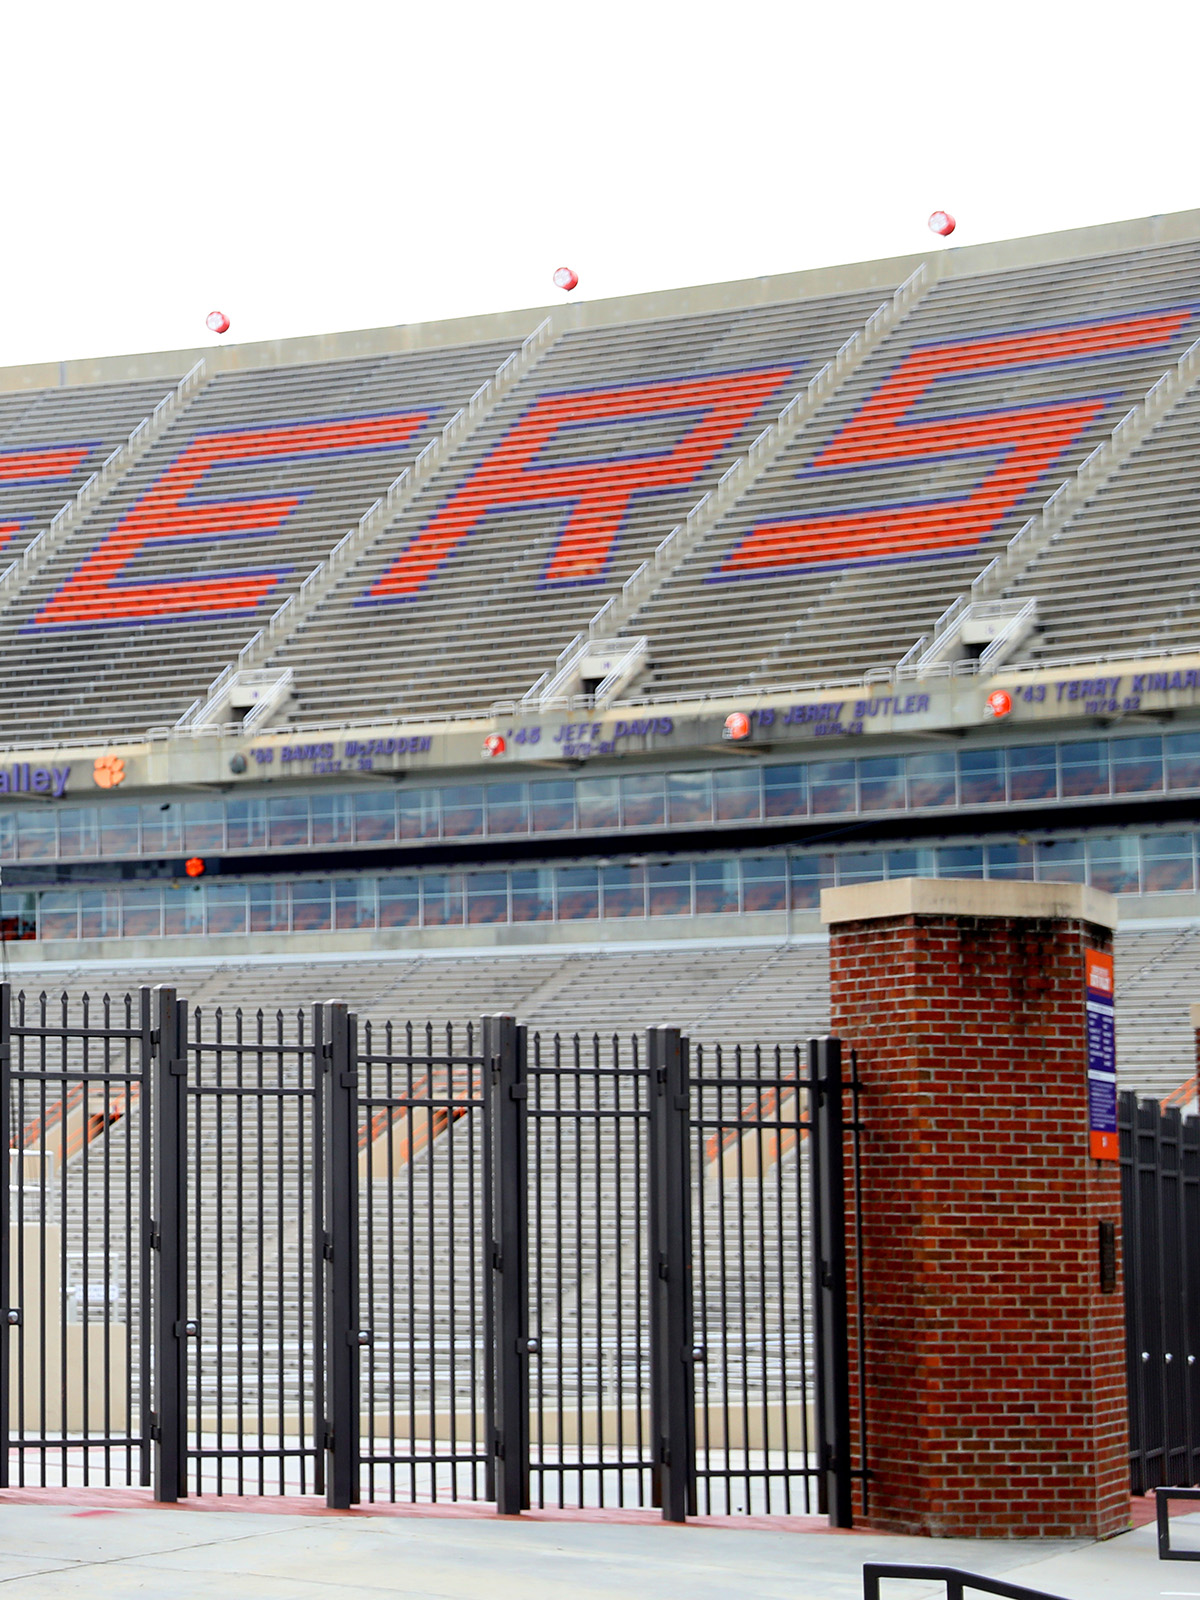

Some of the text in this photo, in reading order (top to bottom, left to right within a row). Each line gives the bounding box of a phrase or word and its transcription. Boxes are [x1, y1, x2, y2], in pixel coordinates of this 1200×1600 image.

[1056, 677, 1121, 702] TERRY
[1131, 669, 1200, 693] KINAR
[783, 702, 844, 725] JERRY
[854, 694, 930, 717] BUTLER
[553, 722, 602, 742] JEFF
[614, 717, 674, 738] DAVIS
[281, 742, 334, 762] BANKS
